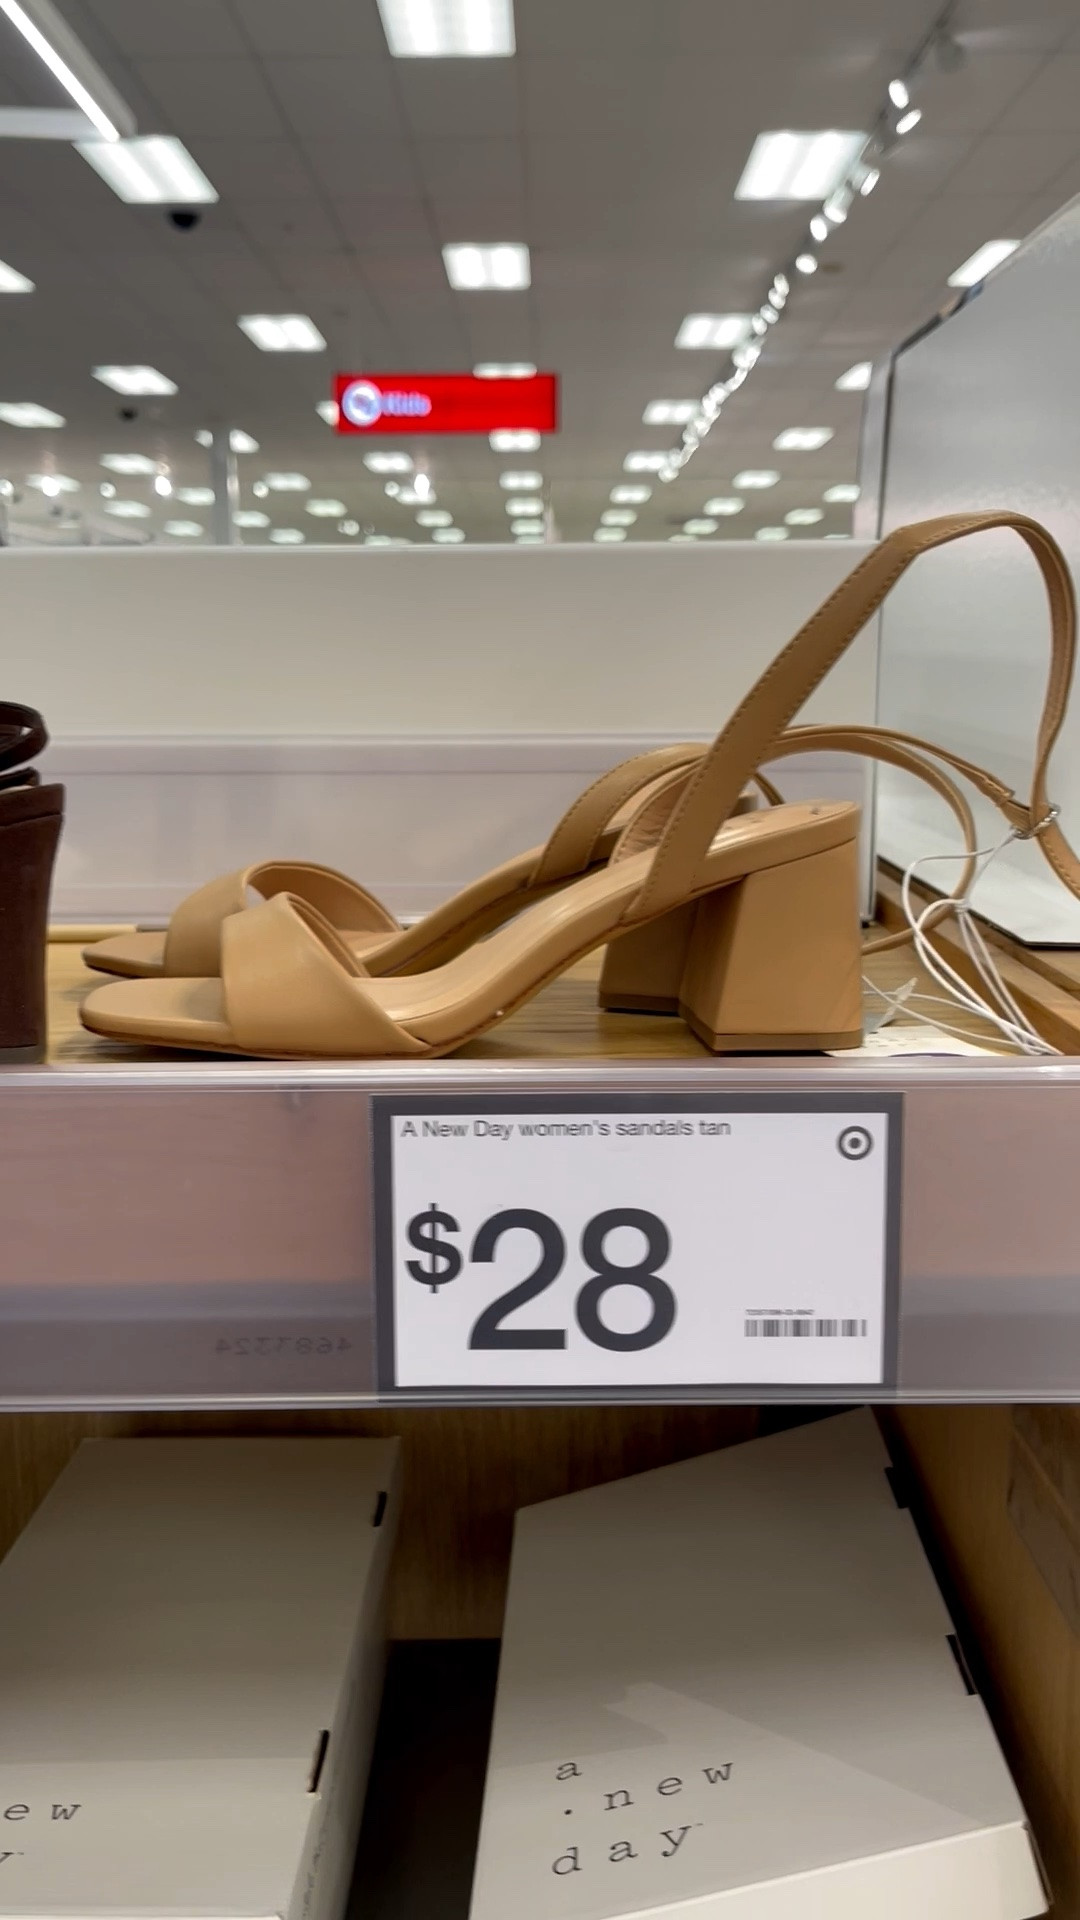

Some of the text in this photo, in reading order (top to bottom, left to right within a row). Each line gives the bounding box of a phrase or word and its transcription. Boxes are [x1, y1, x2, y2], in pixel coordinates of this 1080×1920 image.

[400, 1119, 731, 1141] A New Day women's sandals tan
[404, 1202, 678, 1353] $28
[555, 1761, 583, 1781] a
[551, 1825, 693, 1876] day
